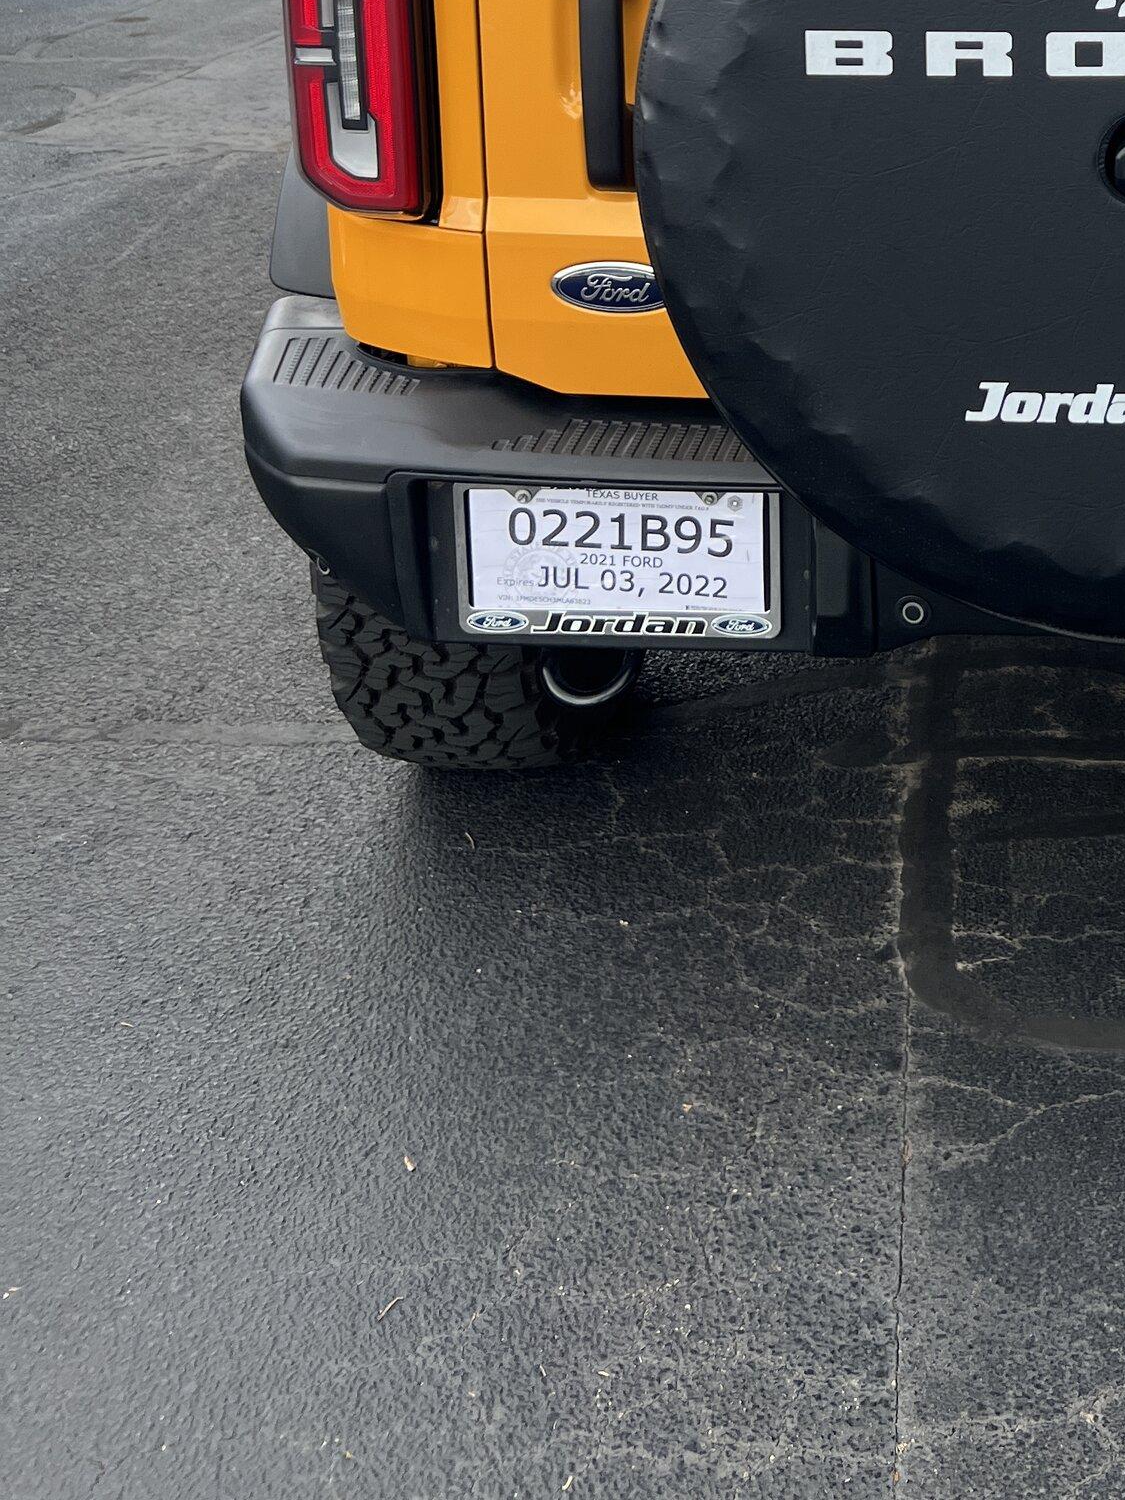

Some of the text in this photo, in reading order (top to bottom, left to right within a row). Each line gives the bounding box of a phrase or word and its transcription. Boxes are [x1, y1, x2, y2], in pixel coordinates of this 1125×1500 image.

[580, 273, 651, 302] Ford
[586, 489, 659, 501] TEXAS BUYER
[508, 507, 735, 558] 0221B95
[580, 553, 663, 569] 2021 FORD
[497, 566, 728, 599] Expires JUL 03, 2022
[531, 612, 708, 636] Jordan
